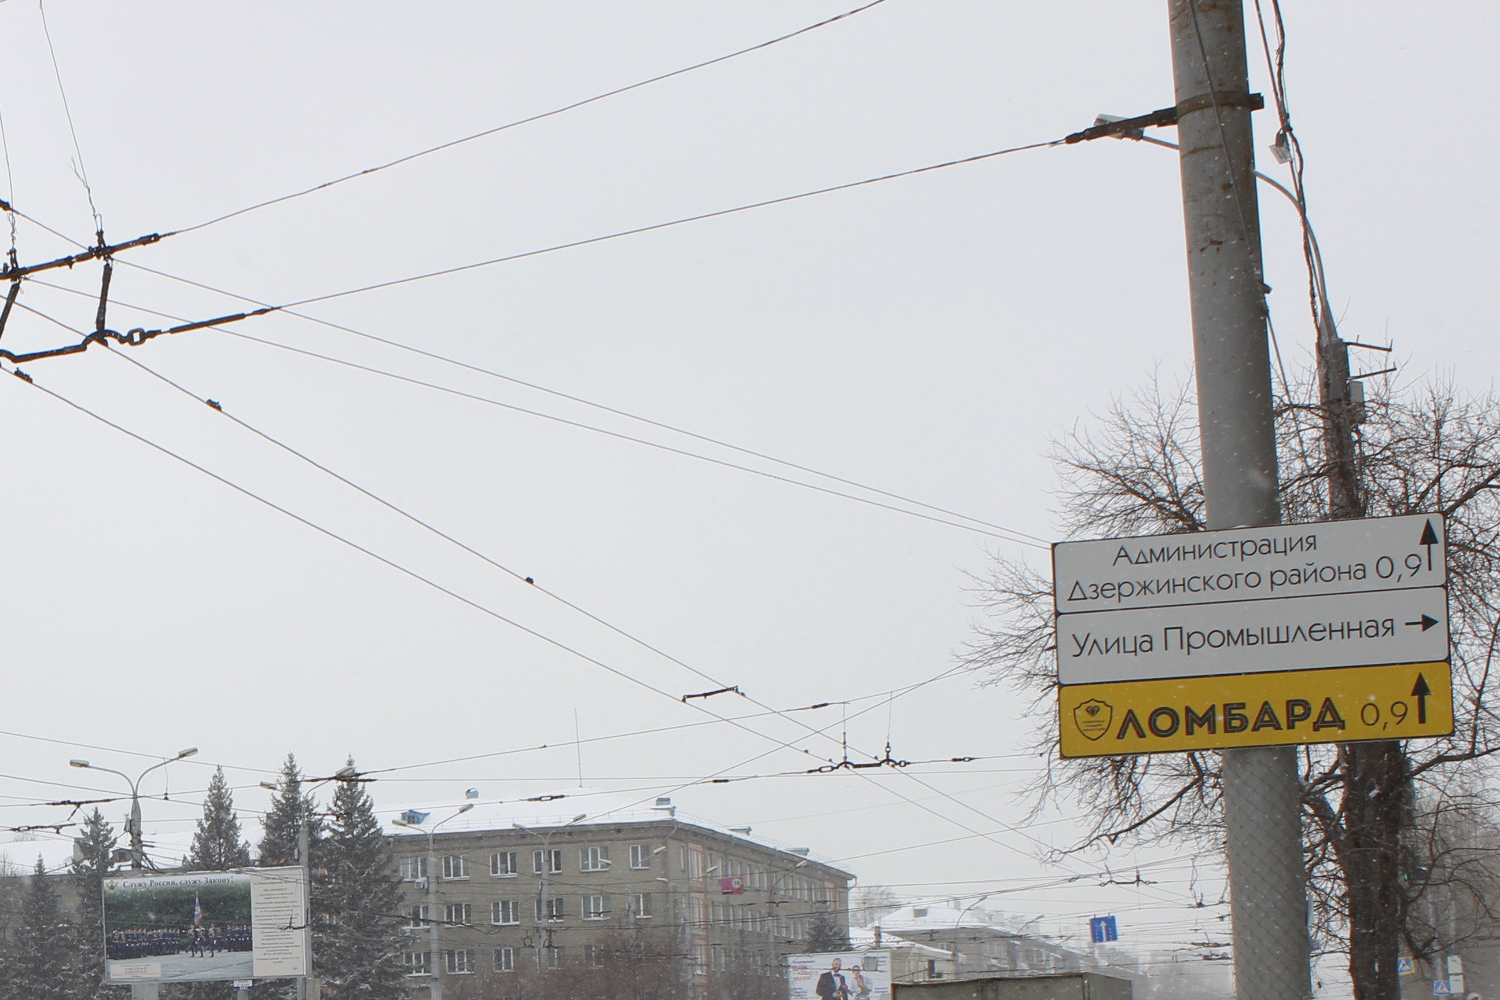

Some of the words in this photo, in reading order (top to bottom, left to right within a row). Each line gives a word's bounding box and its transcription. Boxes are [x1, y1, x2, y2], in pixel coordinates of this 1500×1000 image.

[1112, 534, 1318, 566] Администрация
[1067, 570, 1262, 602] Дзержинского
[1269, 560, 1368, 592] района
[1375, 553, 1423, 584] 0,9
[1071, 631, 1154, 657] Улица
[1164, 617, 1396, 655] Промышленная
[1116, 696, 1346, 740] ЛОМБАРД
[1360, 701, 1409, 731] 0,9
[123, 880, 149, 889] Служу
[150, 878, 178, 888] России,
[179, 878, 201, 887] служу
[204, 875, 234, 885] Закону!
